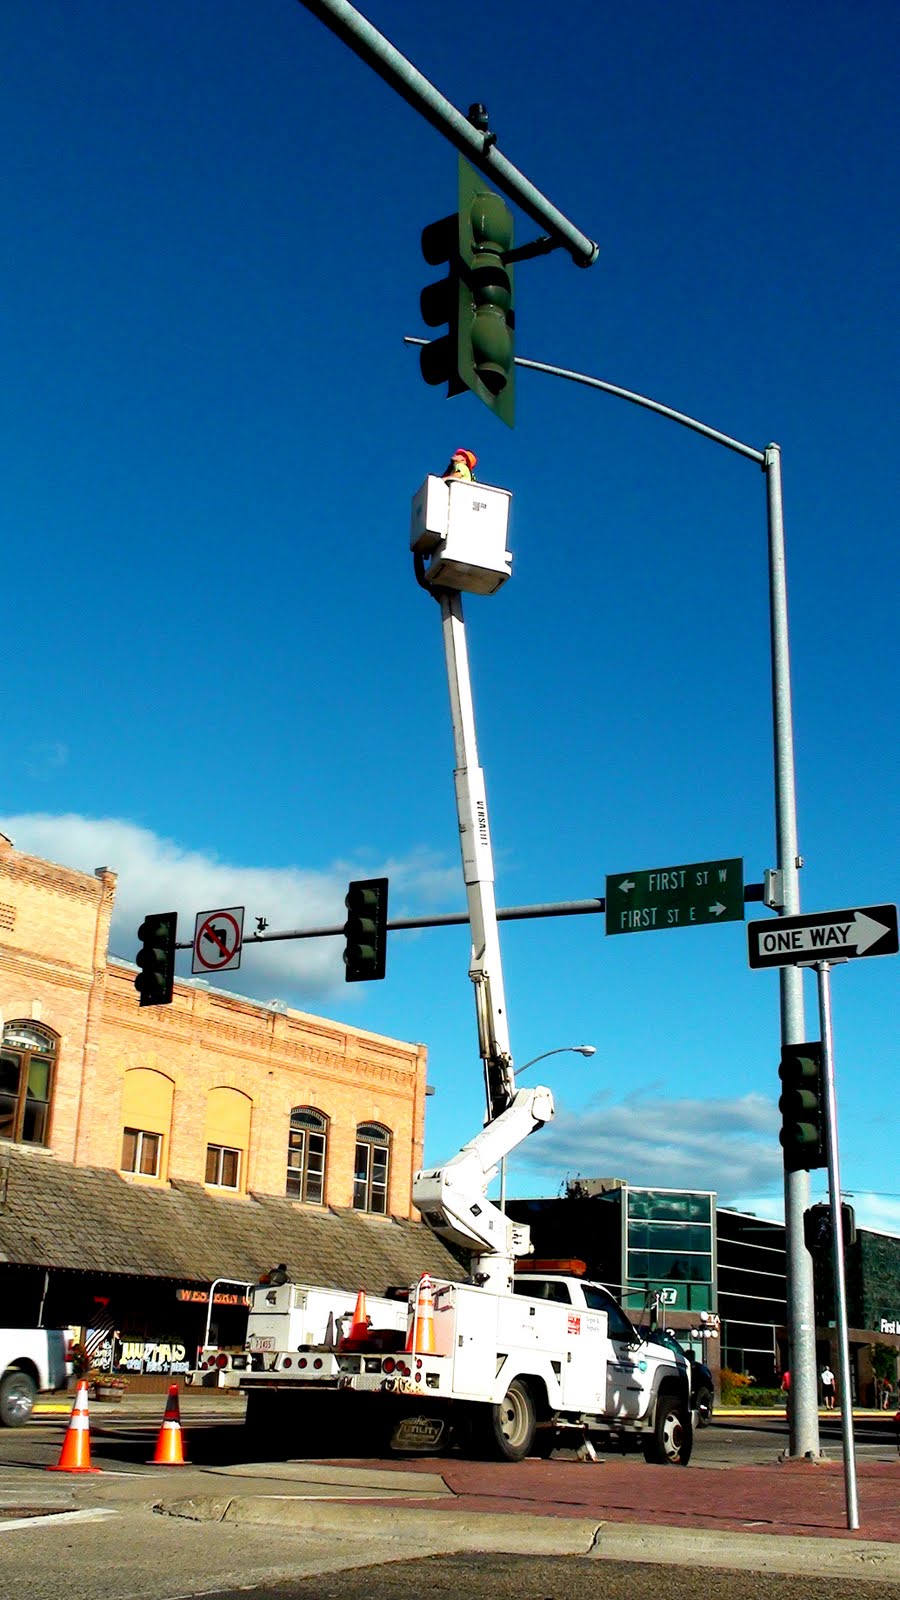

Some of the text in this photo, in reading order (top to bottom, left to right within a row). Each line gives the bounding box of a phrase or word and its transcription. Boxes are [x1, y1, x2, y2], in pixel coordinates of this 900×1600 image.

[649, 869, 727, 892] FIRST ST W
[620, 907, 696, 928] FIRST ST E
[763, 924, 852, 952] ONE WAY
[180, 1289, 239, 1305] WESERN
[880, 1318, 896, 1334] First
